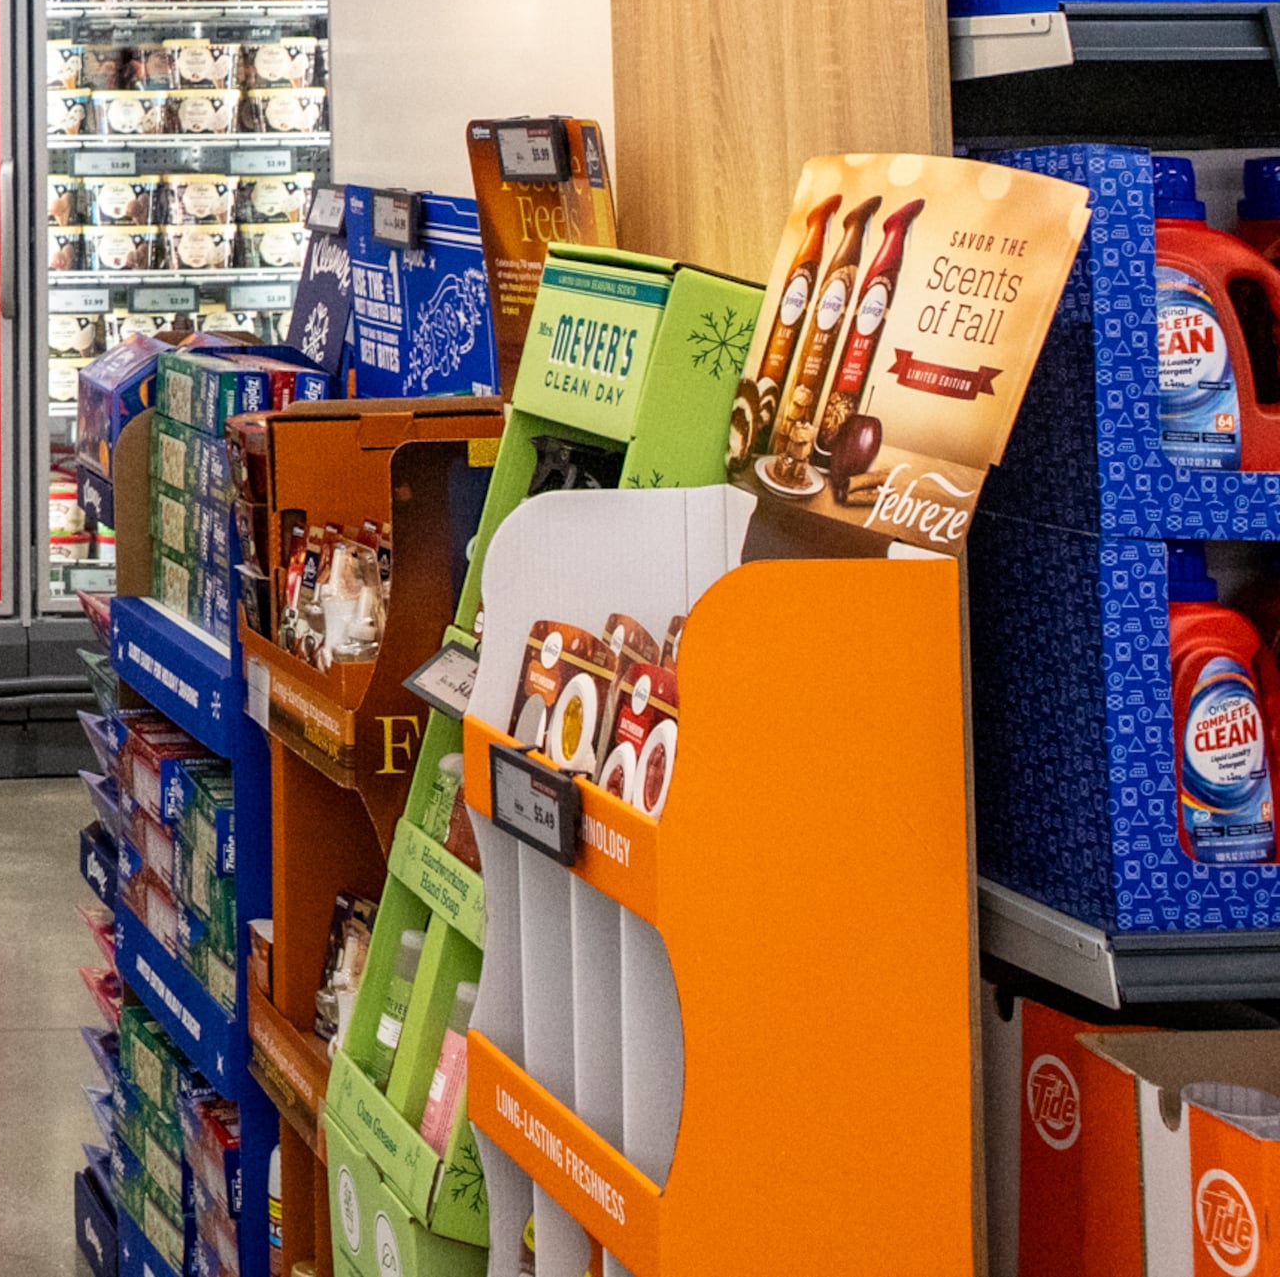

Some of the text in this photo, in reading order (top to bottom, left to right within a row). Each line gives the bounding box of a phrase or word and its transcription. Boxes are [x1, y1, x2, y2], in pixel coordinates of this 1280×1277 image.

[516, 196, 582, 244] Feels
[950, 230, 1028, 257] SAVOR THE
[926, 256, 1023, 303] Scents
[778, 328, 792, 339] AIR
[814, 332, 829, 344] AIR
[918, 300, 1004, 346] of Fall
[1158, 314, 1204, 331] PLETE
[549, 313, 638, 382] MEYER'S
[853, 337, 870, 350] AIR
[1159, 328, 1215, 356] EAN
[245, 378, 262, 412] Ziploc
[304, 379, 323, 401] Zip
[544, 370, 625, 407] CLEAN DAY
[906, 367, 972, 392] LIMITED EDITION
[1218, 416, 1234, 429] 64
[864, 462, 969, 544] febreze
[1195, 702, 1252, 733] COMPLETE
[1208, 698, 1241, 717] Original
[1194, 715, 1258, 754] CLEAN
[533, 801, 556, 831] $5.49
[581, 812, 632, 869] HNOLOGY
[1031, 1072, 1077, 1128] Tide
[495, 1084, 626, 1226] LONG-LASTING FRESHNESS
[1199, 1188, 1256, 1253] Tide
